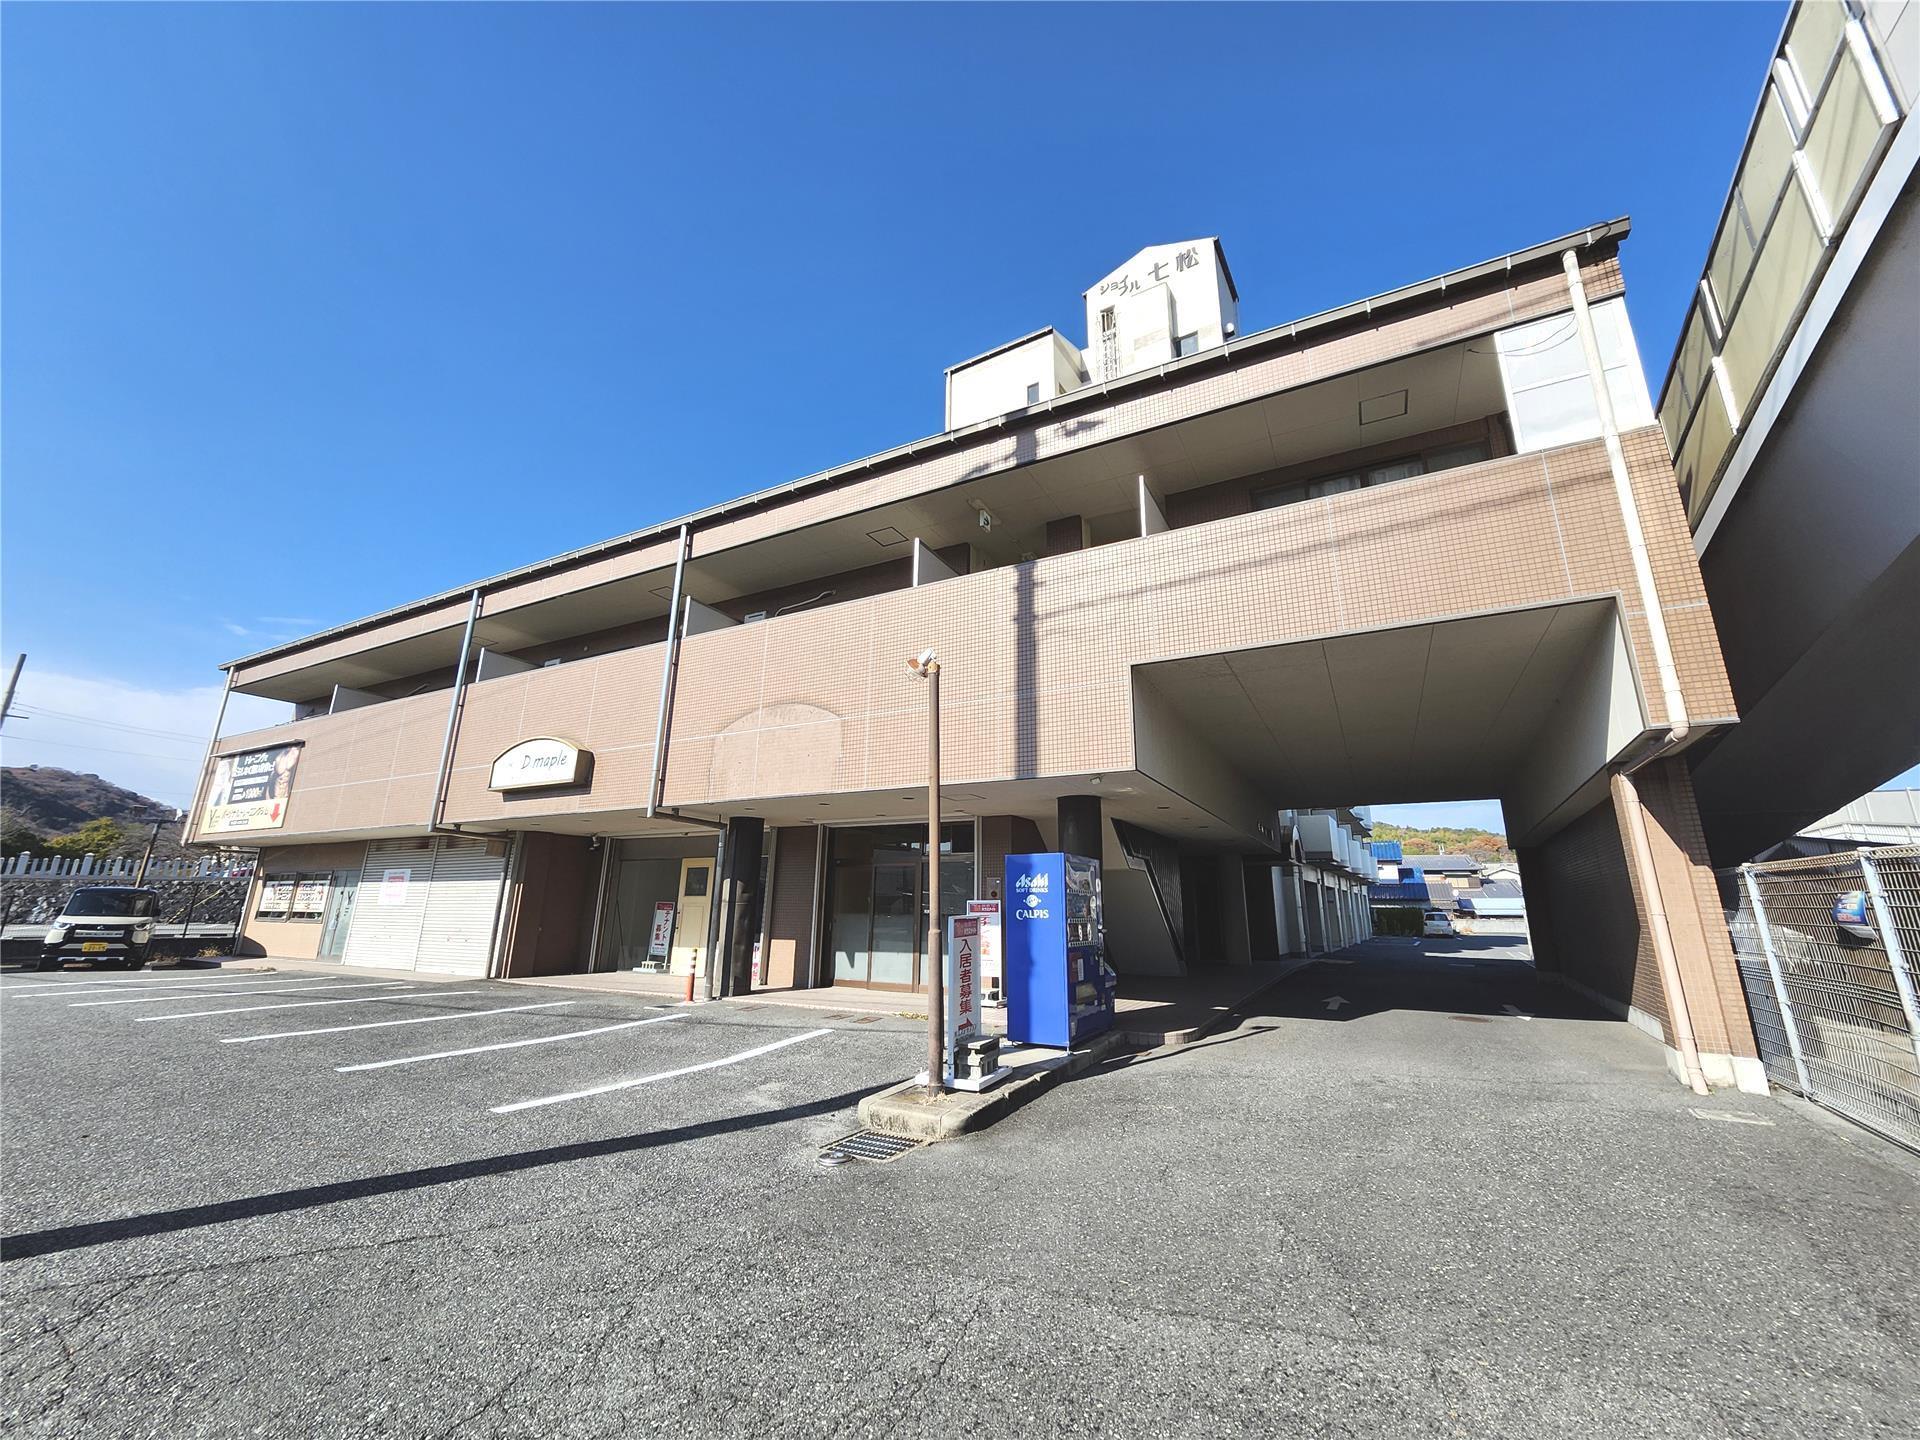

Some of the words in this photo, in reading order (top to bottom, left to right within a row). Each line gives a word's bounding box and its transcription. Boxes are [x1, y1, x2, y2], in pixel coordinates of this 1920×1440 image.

[1147, 247, 1199, 281] 七松
[1015, 872, 1049, 888] Asahi
[662, 910, 671, 941] テナント
[1015, 909, 1050, 921] CALPIS
[959, 938, 972, 1015] 入居者募集
